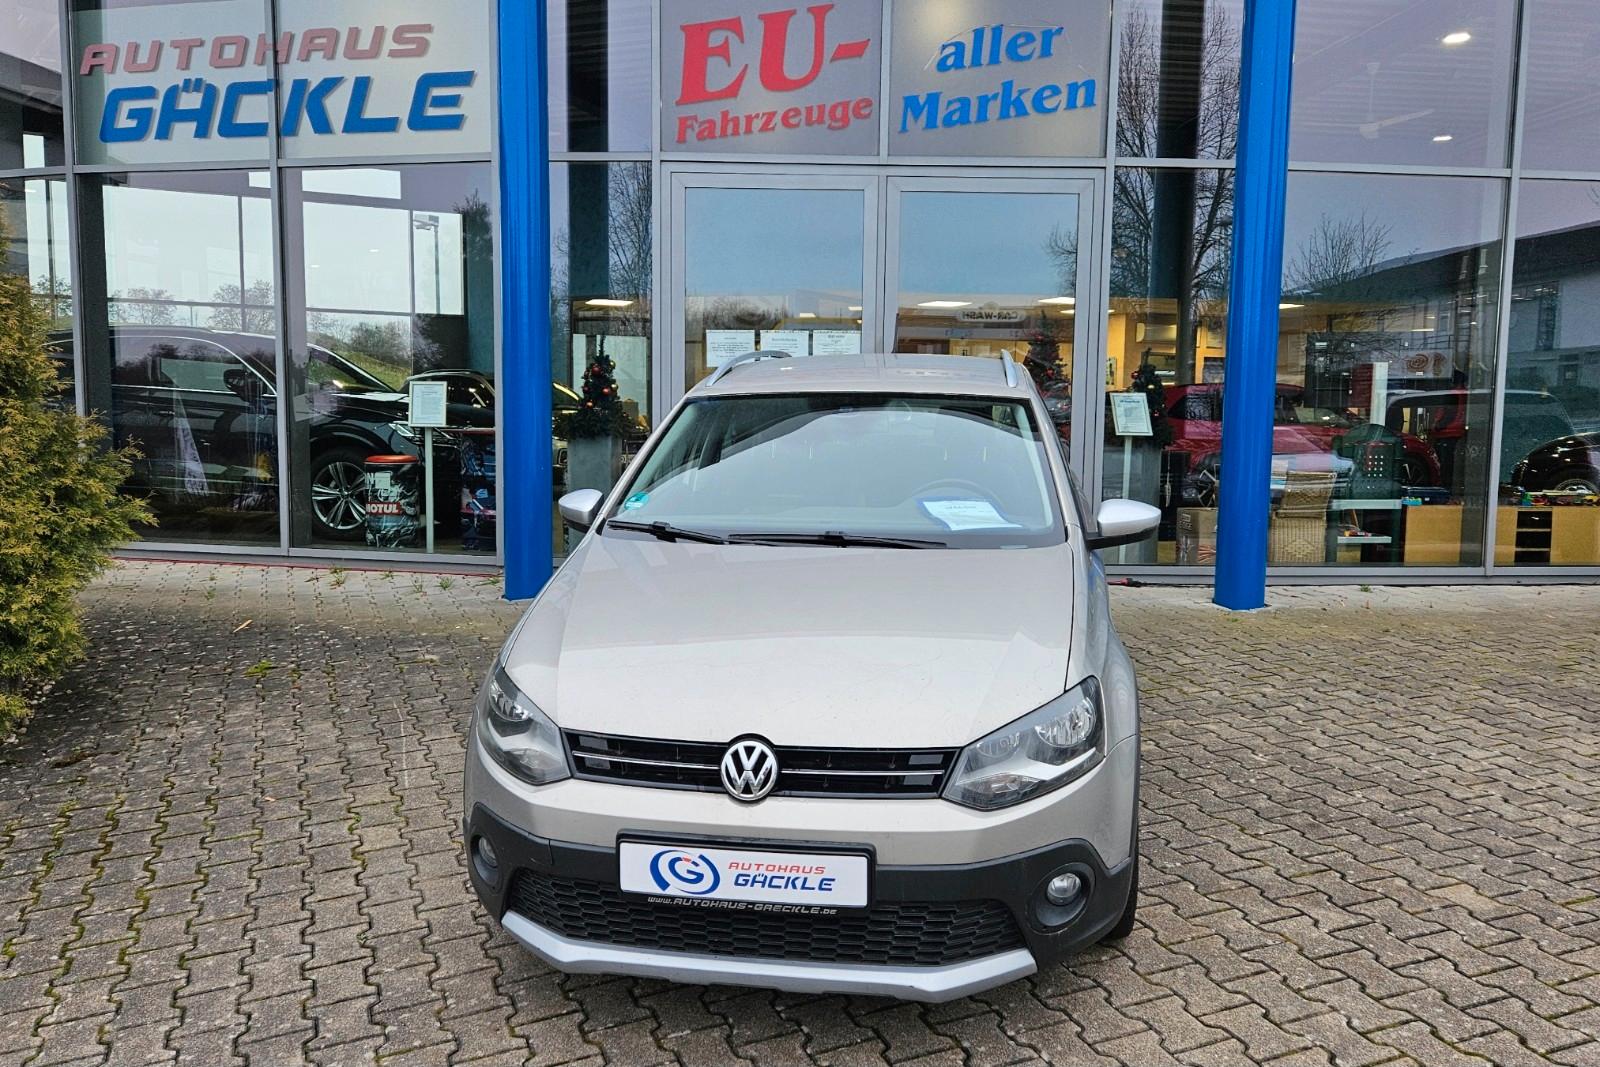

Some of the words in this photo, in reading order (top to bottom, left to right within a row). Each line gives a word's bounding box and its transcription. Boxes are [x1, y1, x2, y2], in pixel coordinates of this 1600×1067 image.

[79, 24, 433, 75] AUTOHAUS
[675, 3, 870, 106] EU-
[936, 24, 1064, 73] aller
[99, 70, 475, 144] GÄCKLE
[675, 97, 873, 144] Fahrzeuge
[900, 76, 1097, 134] Marken
[728, 861, 826, 875] AUTOHAUS
[733, 872, 836, 892] GÄCKLE
